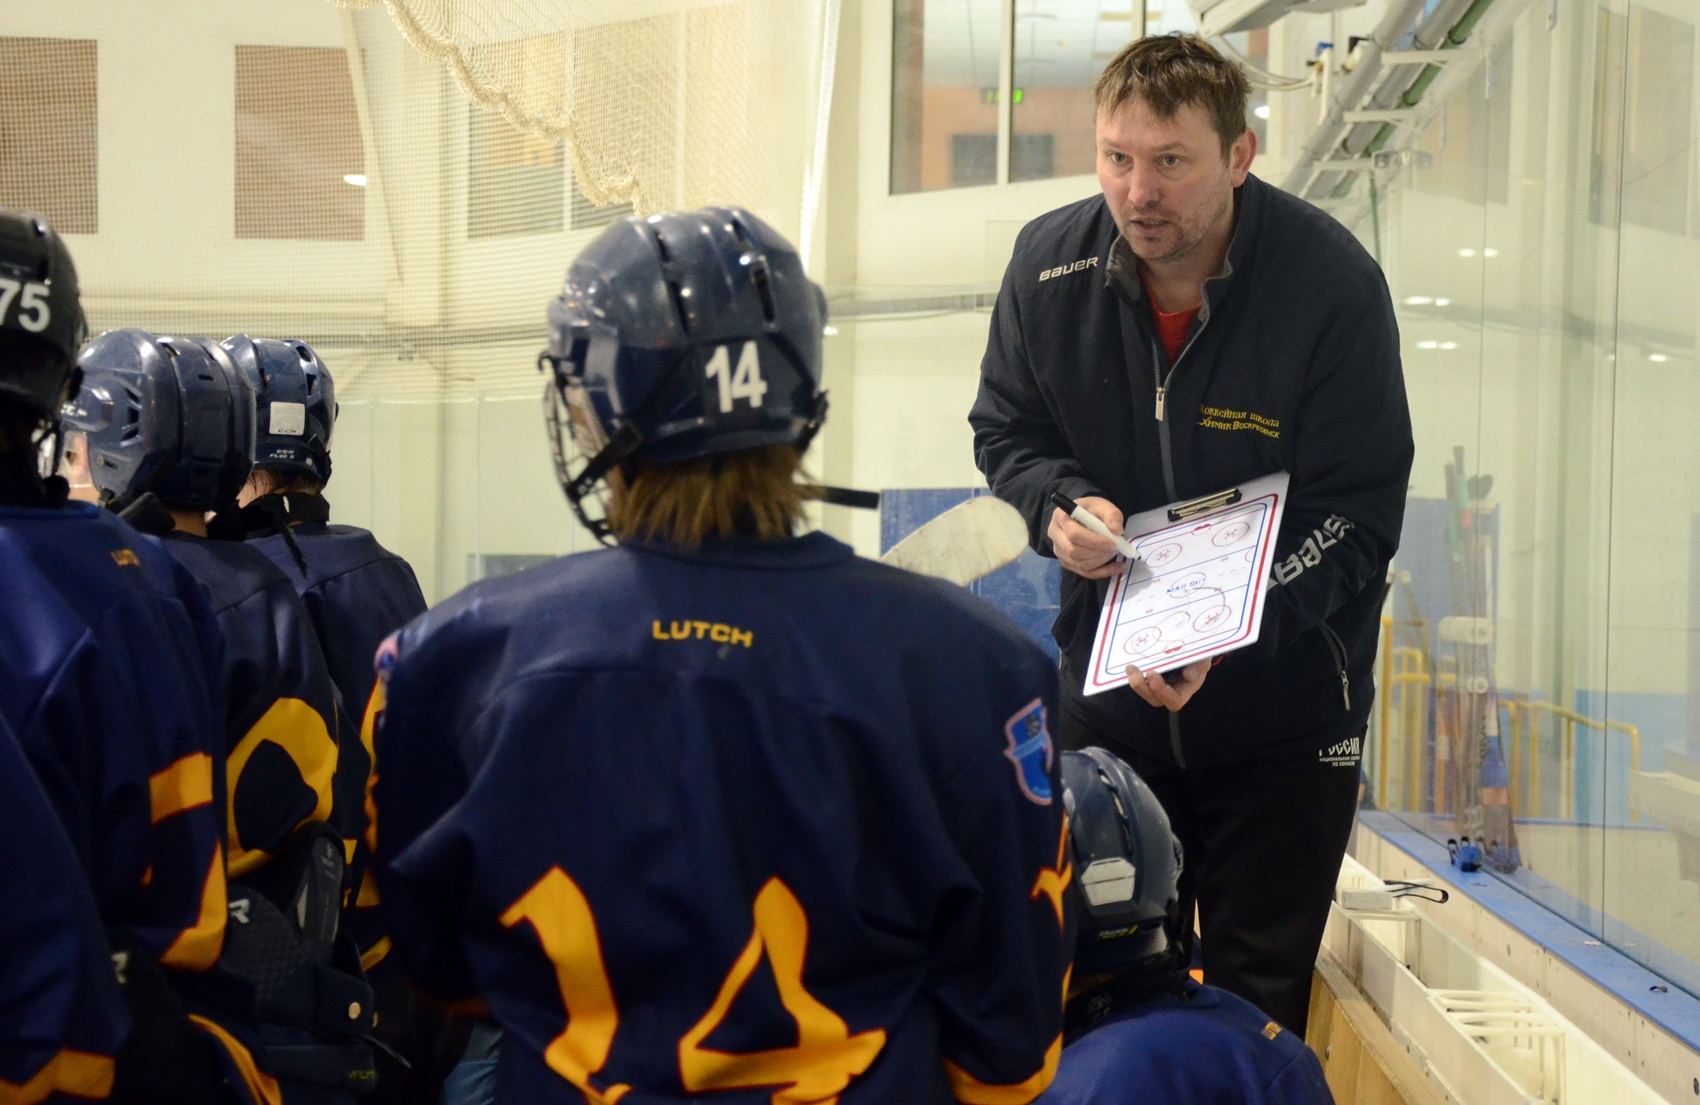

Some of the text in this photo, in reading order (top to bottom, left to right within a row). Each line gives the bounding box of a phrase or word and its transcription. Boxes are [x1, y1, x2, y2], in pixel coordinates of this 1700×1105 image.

[0, 278, 51, 332] 75
[704, 340, 768, 414] 14
[1249, 412, 1280, 427] школа
[651, 619, 754, 649] LUTCH
[499, 864, 887, 1105] 14
